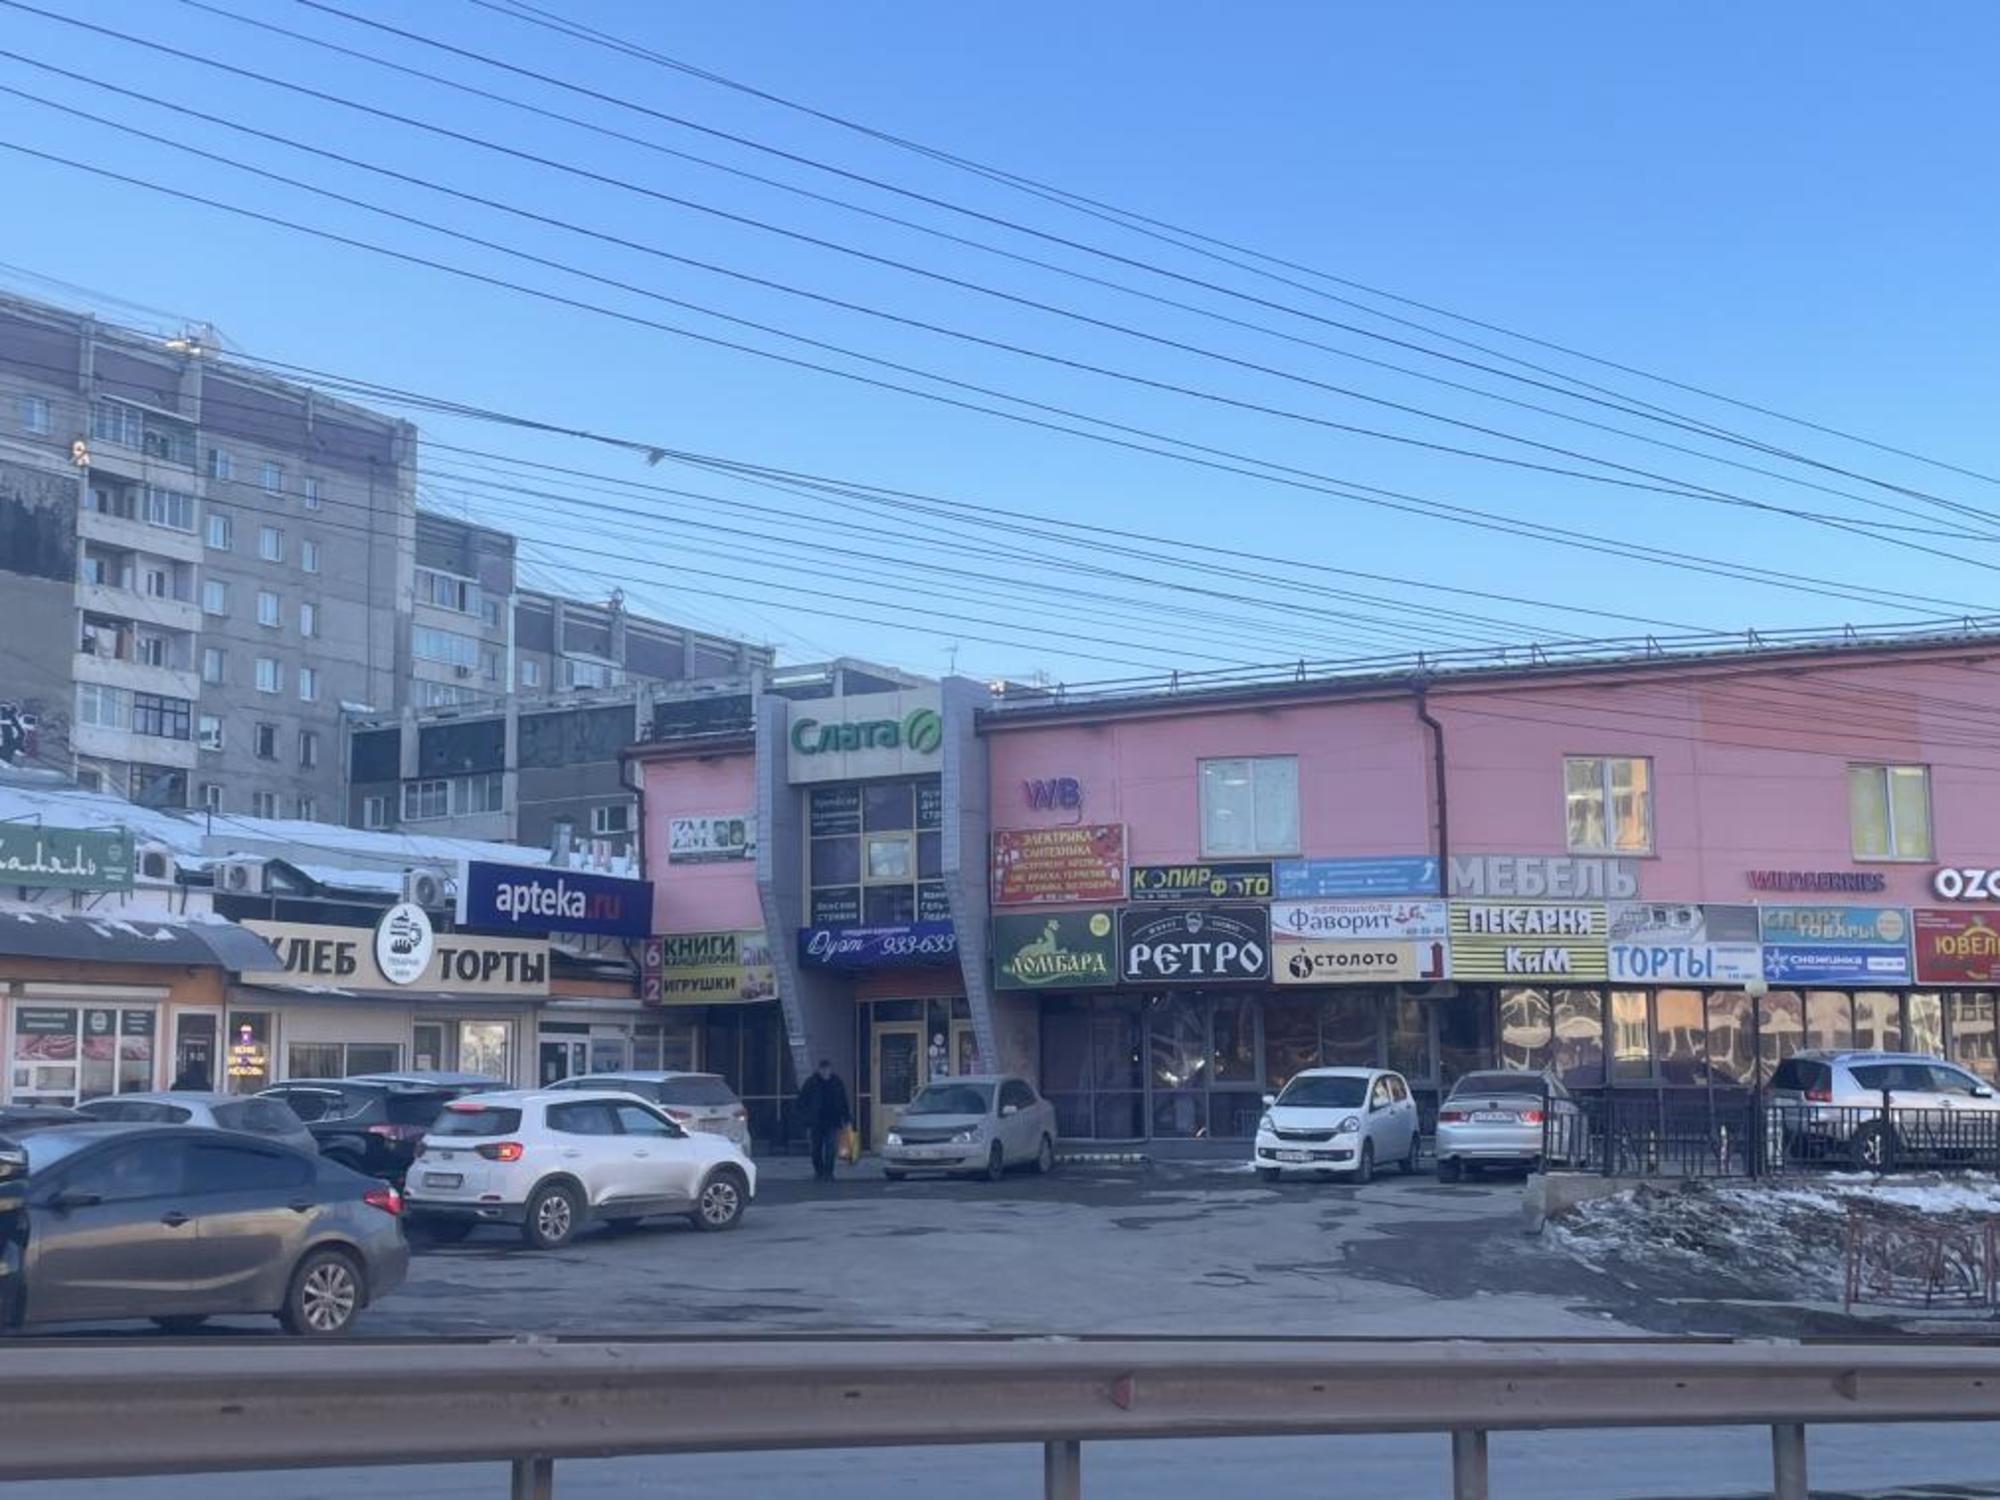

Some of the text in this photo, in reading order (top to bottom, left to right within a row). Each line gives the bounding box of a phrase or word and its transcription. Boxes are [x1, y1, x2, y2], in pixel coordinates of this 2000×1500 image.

[791, 717, 901, 754] Слата
[1024, 777, 1080, 809] WB
[0, 839, 96, 876] аляль
[1452, 855, 1637, 898] МЕБЕЛЬ
[1747, 870, 1886, 892] WILDBERRIES
[496, 878, 622, 921] apteka.ru
[1289, 908, 1393, 934] Фаворит
[1468, 906, 1592, 935] ПЕКАРНЯ
[1799, 922, 1874, 939] ТОВАРЫ
[646, 943, 661, 967] 6
[664, 936, 736, 956] КНИГИ
[807, 930, 863, 962] Дуэт
[1127, 941, 1263, 975] РЕТРО
[1935, 935, 2000, 955] ЮВЕЛ
[437, 949, 545, 984] ТОРТЫ
[1012, 952, 1106, 974] ЛОМБАРД
[1611, 946, 1713, 979] ТОРТЫ
[664, 976, 736, 993] ИГРУШКИ
